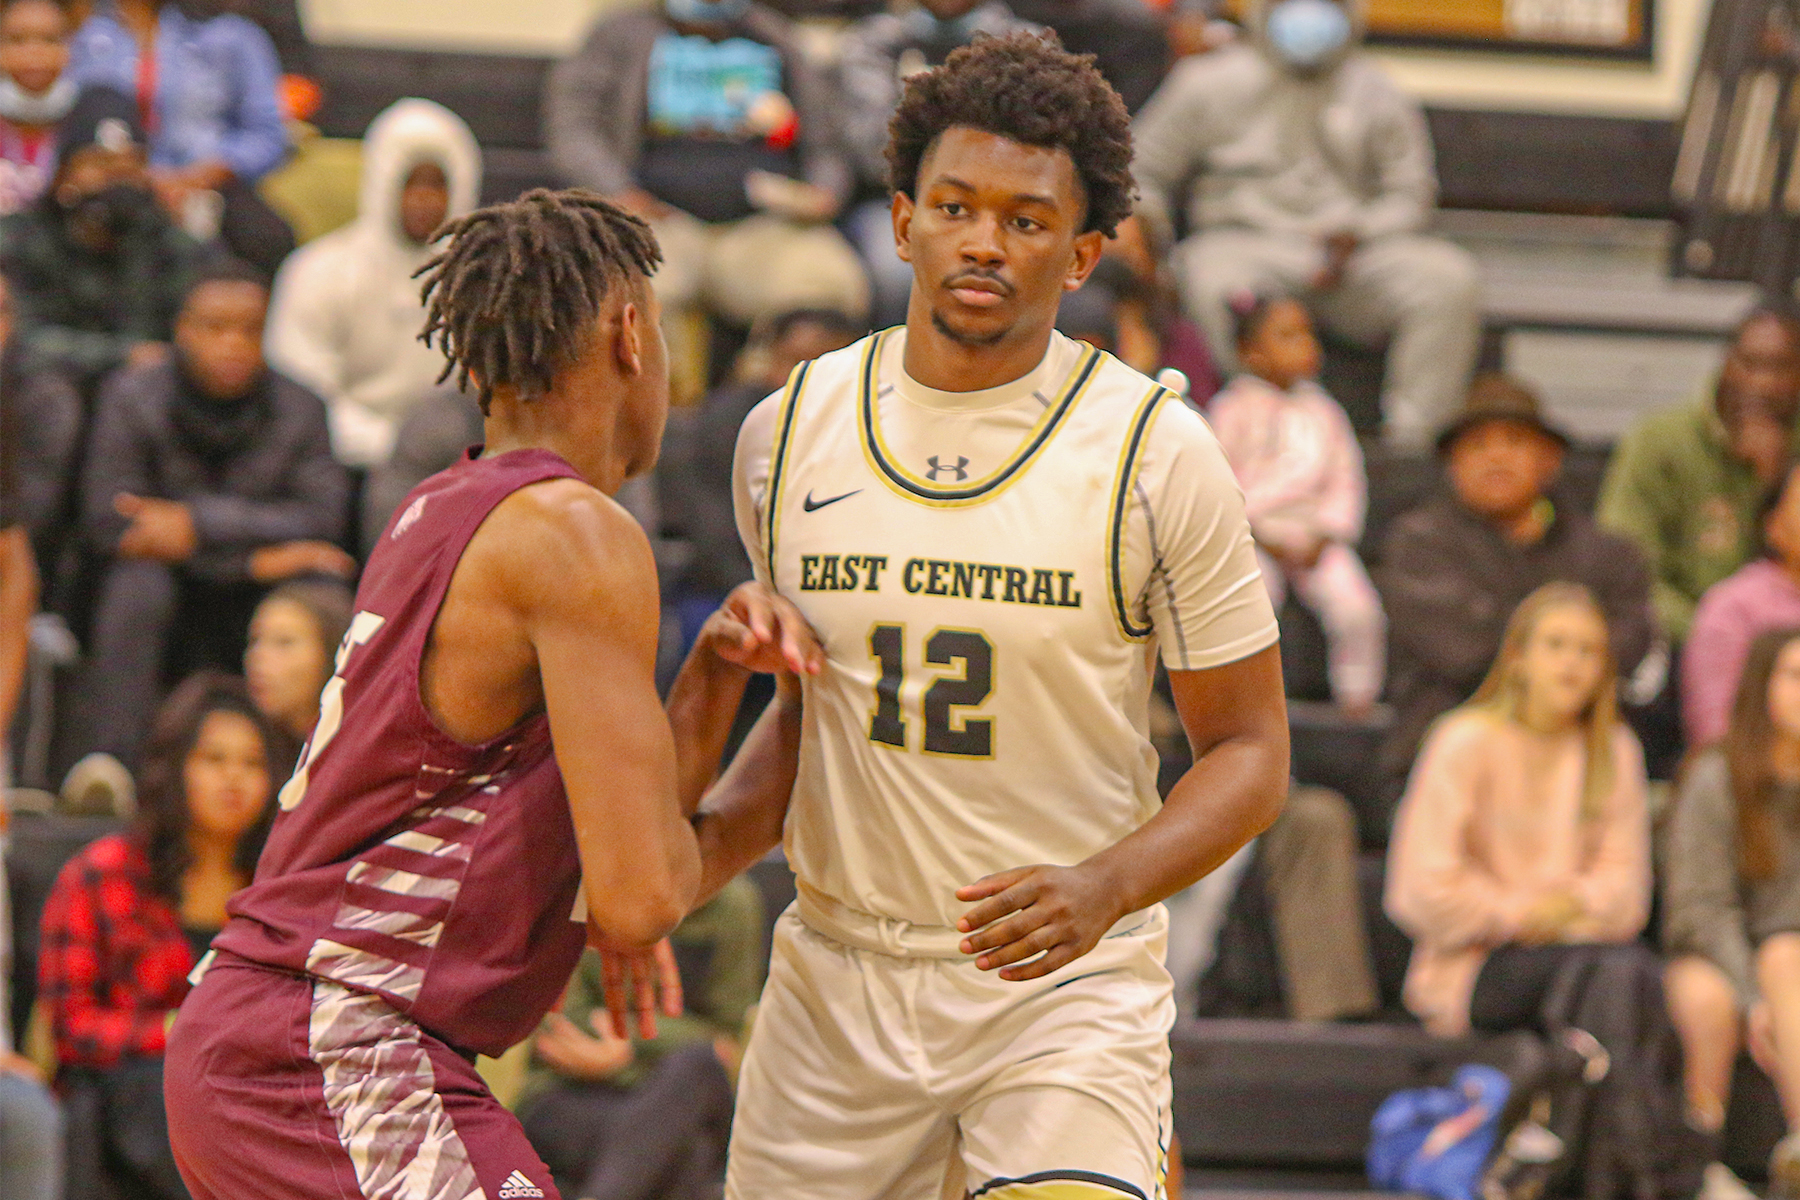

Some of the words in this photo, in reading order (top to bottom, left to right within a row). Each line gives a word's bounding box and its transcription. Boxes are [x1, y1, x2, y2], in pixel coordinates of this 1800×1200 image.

[800, 555, 888, 591] EAST
[902, 557, 1082, 608] CENTRAL
[866, 621, 996, 760] 12
[498, 1186, 545, 1199] adidas
